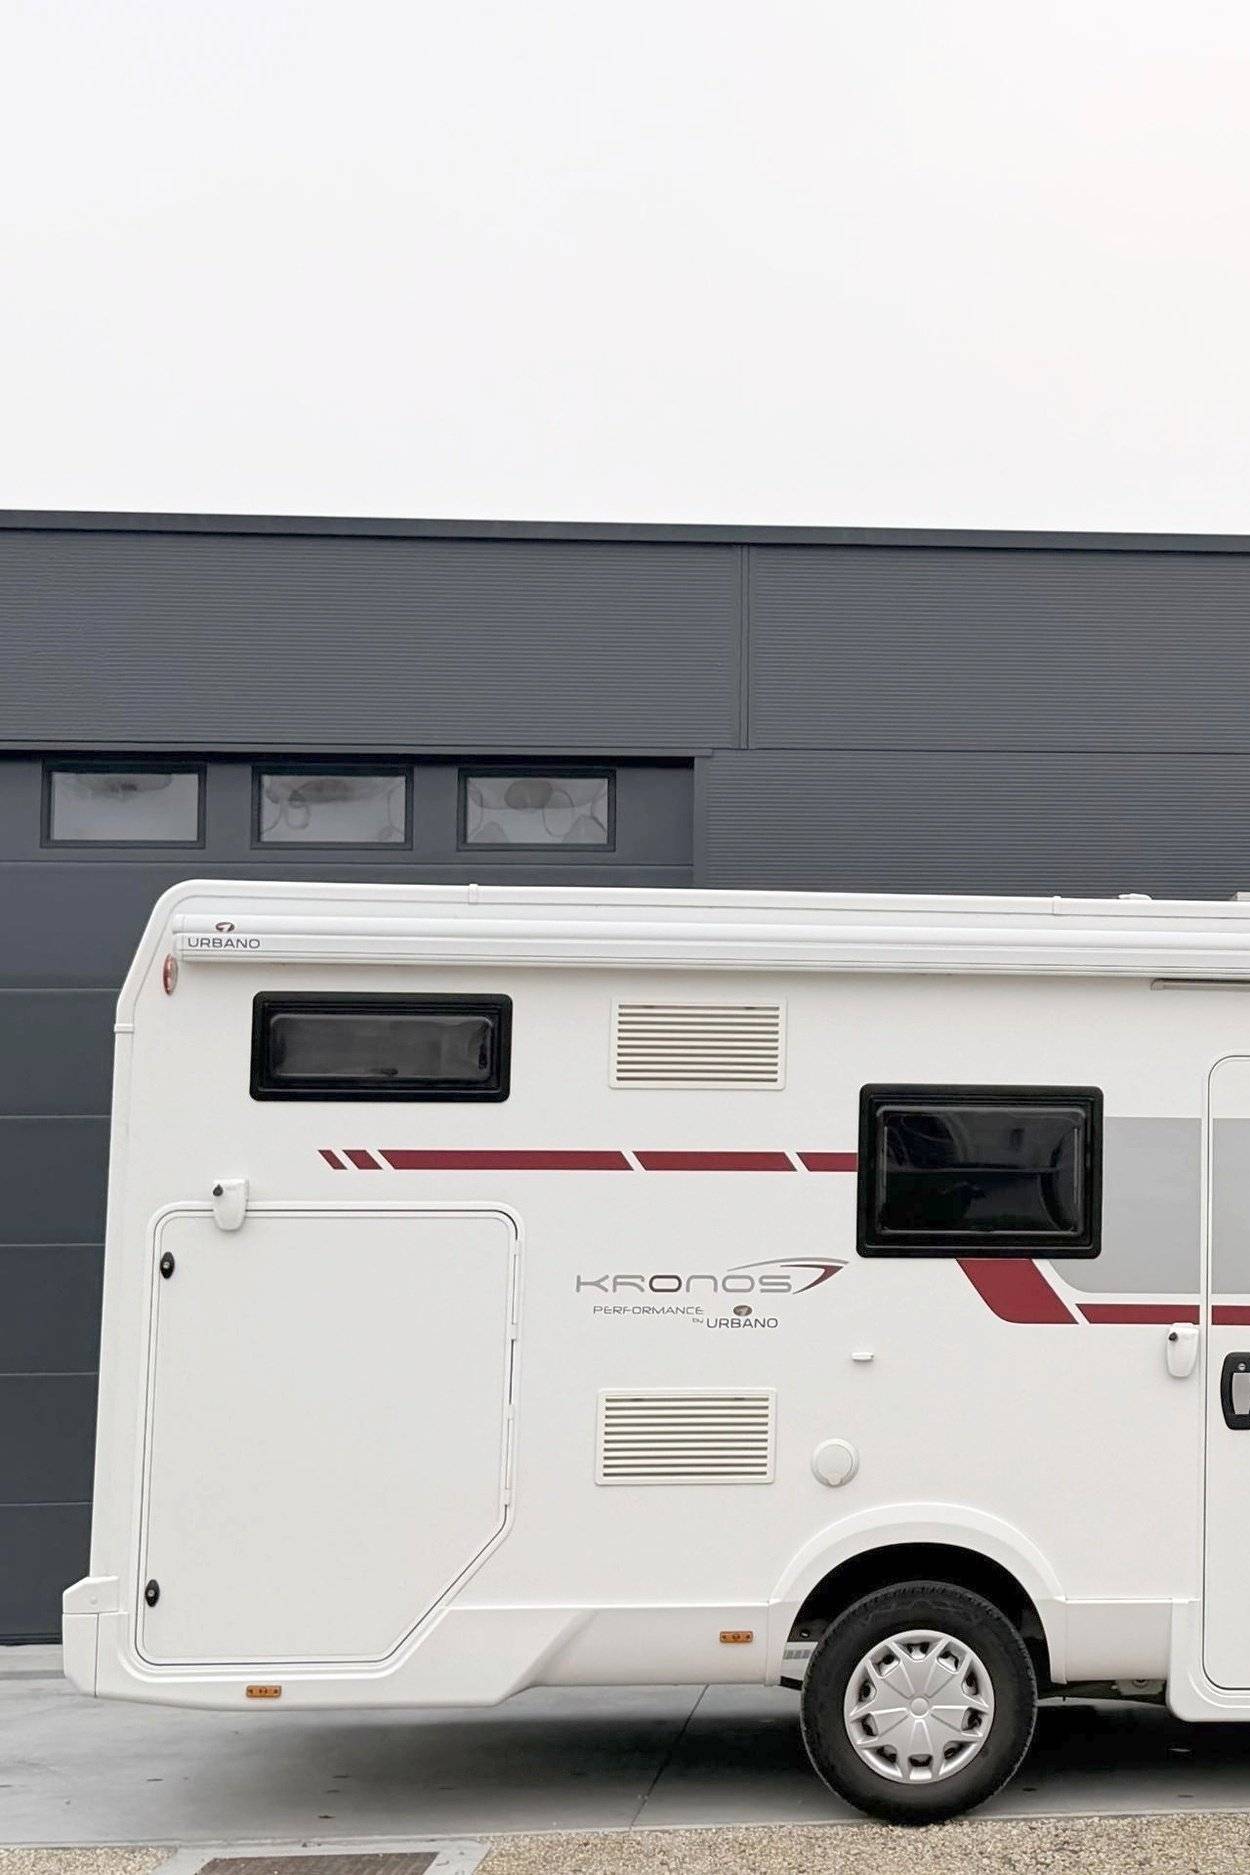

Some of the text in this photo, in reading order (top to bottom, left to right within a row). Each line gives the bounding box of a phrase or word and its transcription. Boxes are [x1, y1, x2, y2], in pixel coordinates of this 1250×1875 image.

[187, 937, 261, 949] URBANO
[575, 1274, 793, 1293] KRONOS
[593, 1305, 704, 1315] PERFORMANCE
[706, 1317, 778, 1329] URBANO
